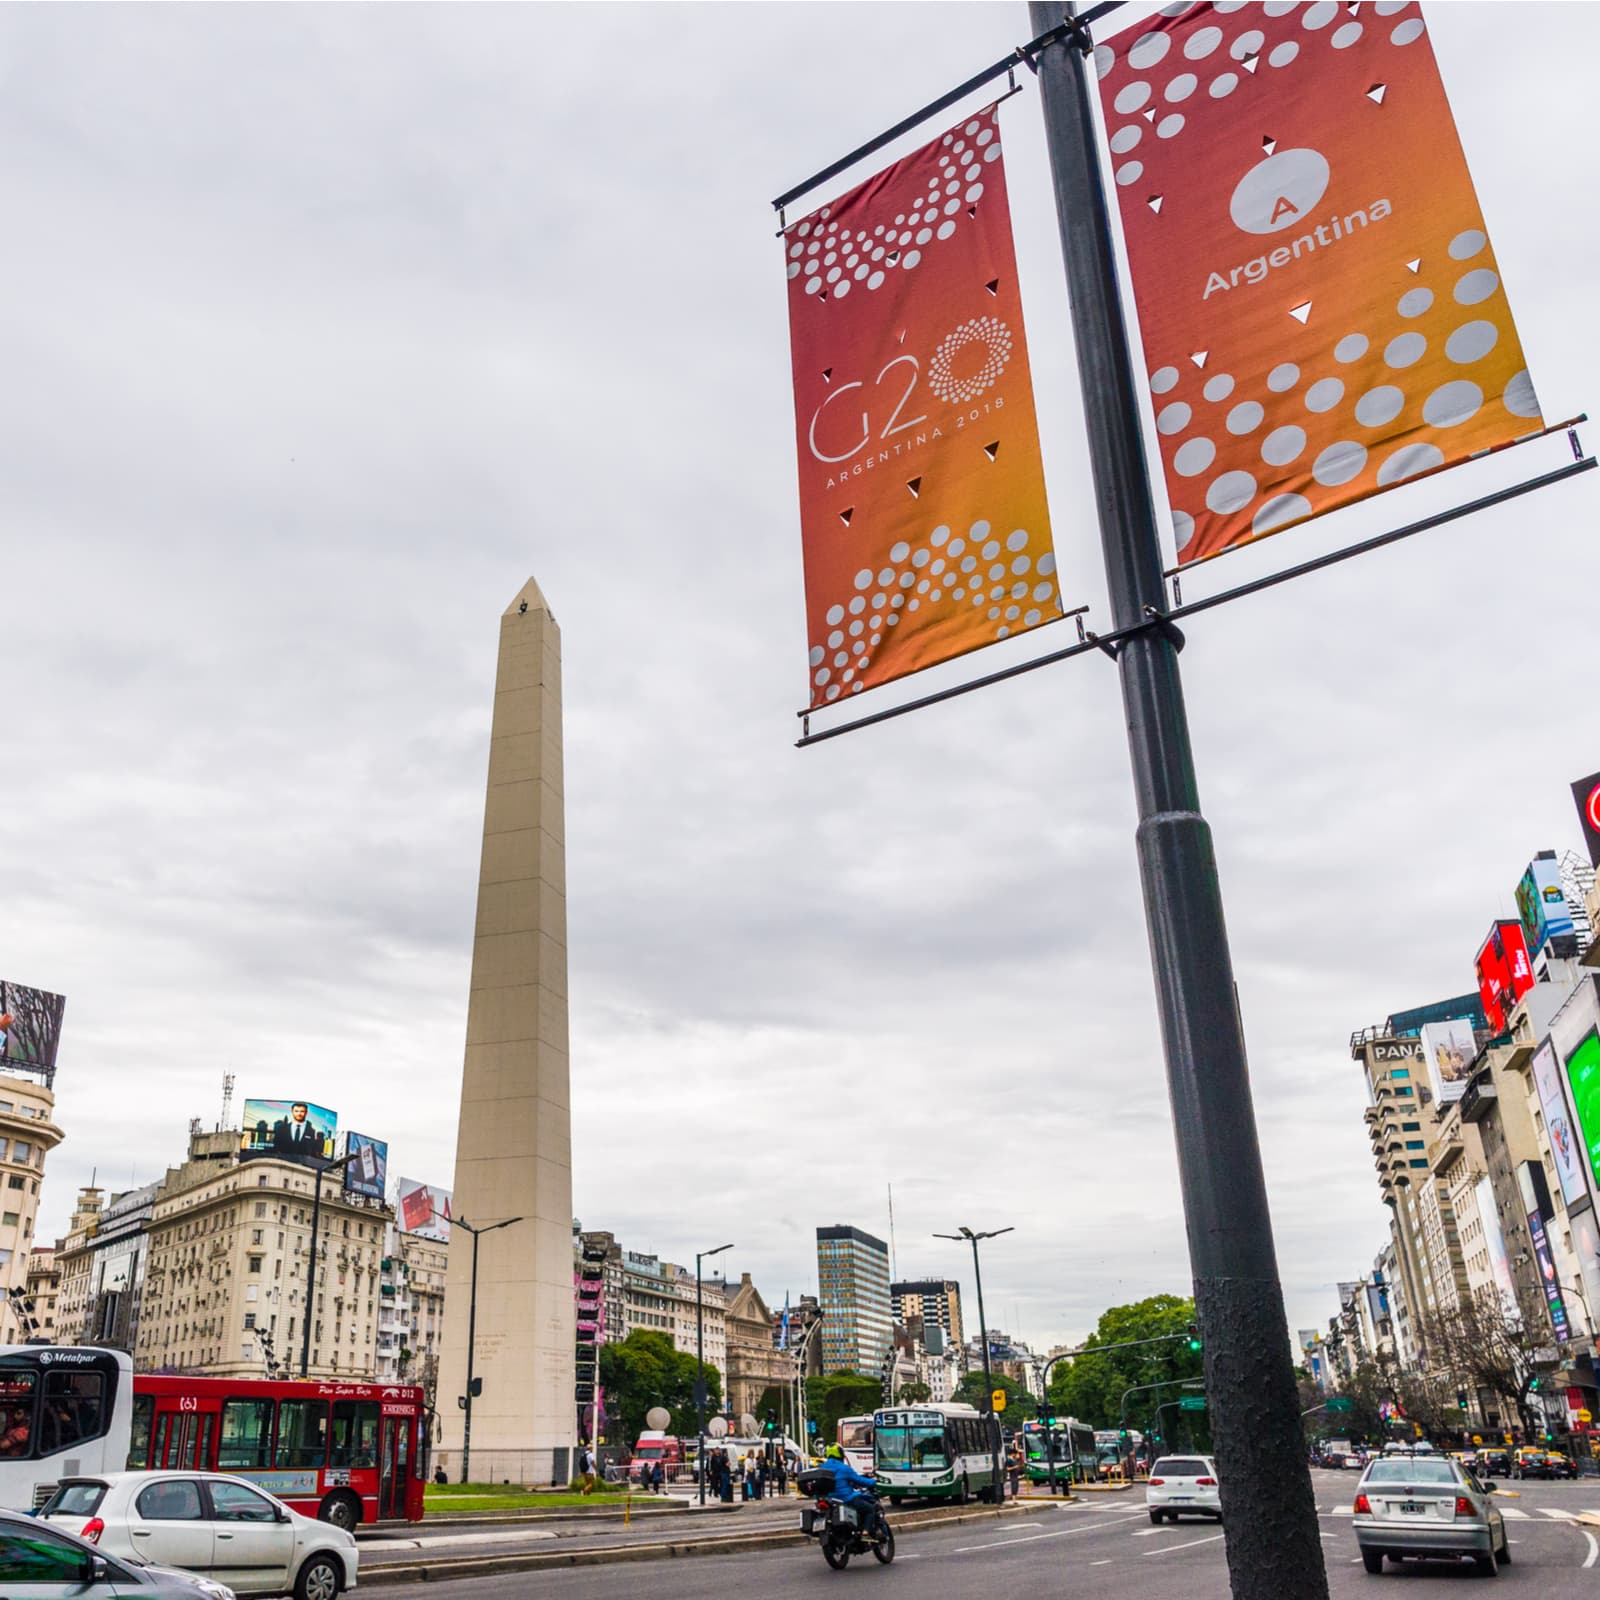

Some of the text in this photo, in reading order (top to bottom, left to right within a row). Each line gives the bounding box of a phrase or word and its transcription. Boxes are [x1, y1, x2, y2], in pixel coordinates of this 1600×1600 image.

[1270, 196, 1299, 225] A
[1202, 198, 1393, 300] Argentina
[809, 315, 1014, 464] G20
[826, 397, 1005, 489] ARGENTINA 2018
[53, 1352, 97, 1365] Metalpar
[318, 1385, 372, 1397] Piso Super Bajo
[884, 1413, 908, 1425] 91
